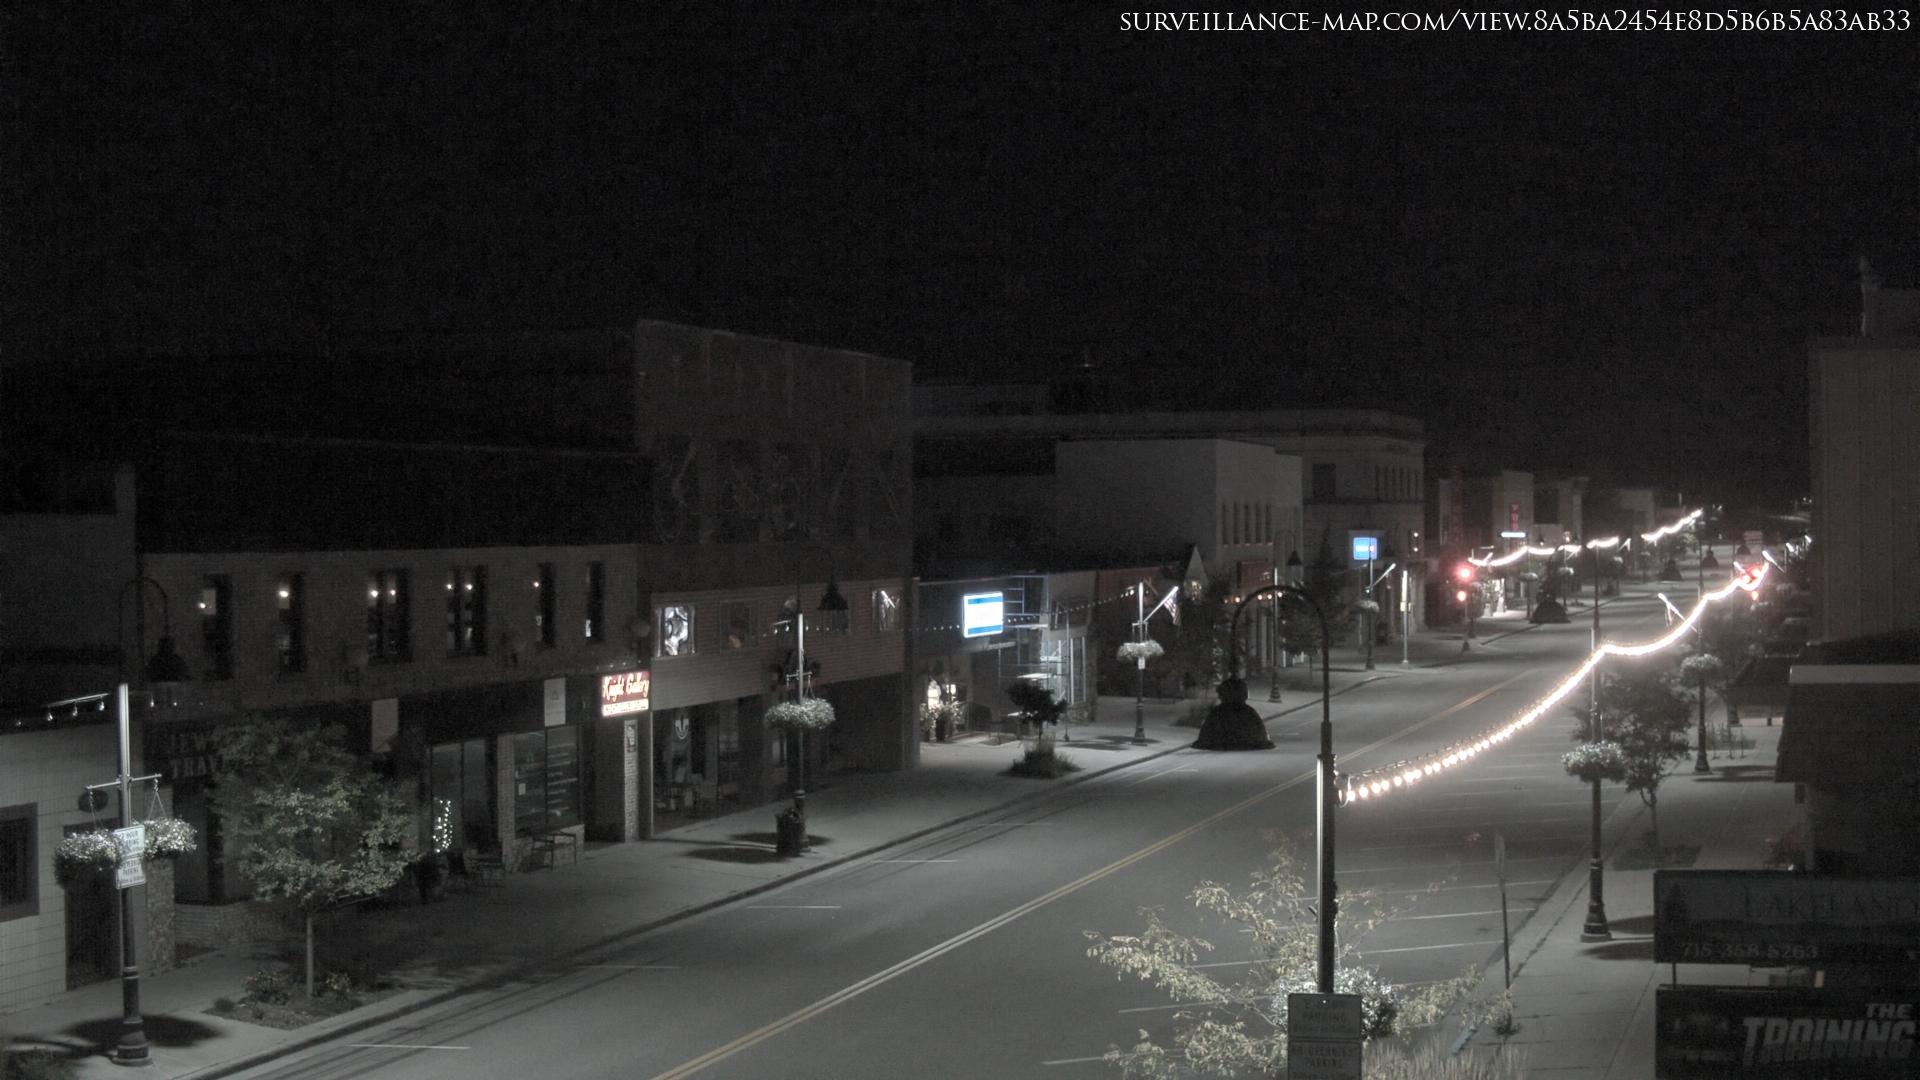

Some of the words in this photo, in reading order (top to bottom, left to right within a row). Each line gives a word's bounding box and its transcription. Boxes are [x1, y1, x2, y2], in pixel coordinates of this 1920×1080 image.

[1682, 942, 1713, 958] 715
[1865, 1002, 1914, 1019] THE
[1743, 1016, 1916, 1067] TRAINING
